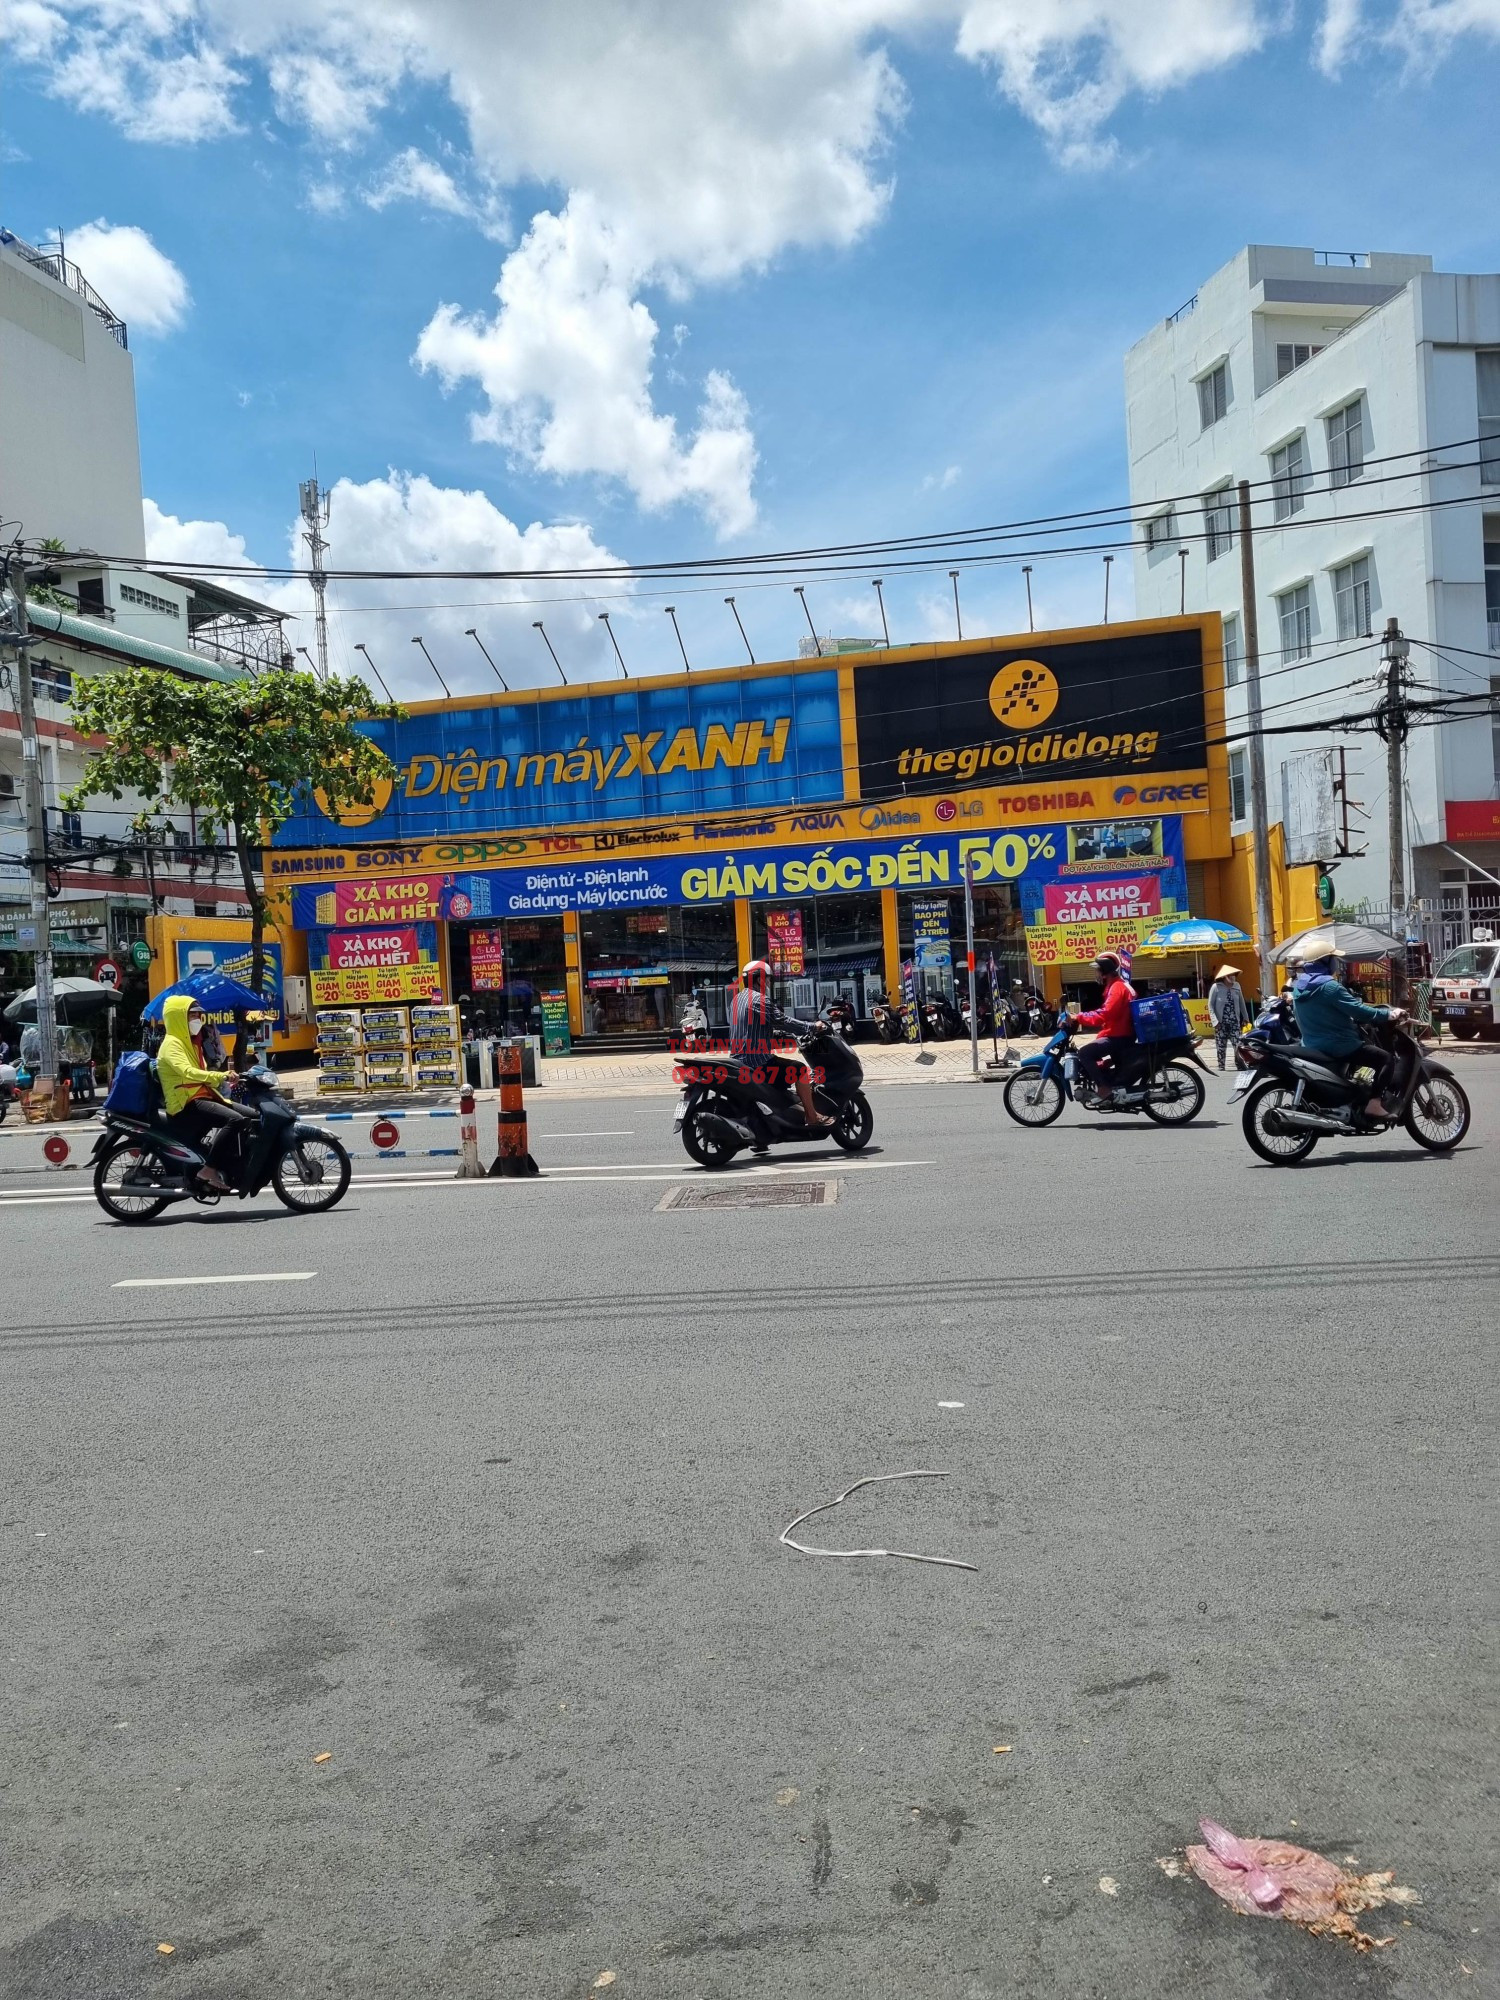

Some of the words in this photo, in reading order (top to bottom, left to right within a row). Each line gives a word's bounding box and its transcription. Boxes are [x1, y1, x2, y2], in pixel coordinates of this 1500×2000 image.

[403, 747, 507, 804] Điện
[515, 737, 620, 790] máy
[615, 718, 791, 777] XANH
[897, 731, 1159, 779] thegioididong
[1139, 783, 1208, 802] GREE
[960, 800, 984, 817] LG
[998, 791, 1095, 814] TOSHIBA
[791, 813, 844, 832] AQUA
[872, 811, 921, 827] Midea
[617, 831, 680, 846] Electrolux
[693, 819, 776, 840] Panasonic
[539, 837, 583, 852] TCL
[271, 855, 345, 874] SAMSUNG
[356, 850, 423, 867] SONY
[681, 856, 777, 900] GIẢM
[783, 847, 863, 892] SỐC
[866, 839, 950, 886] ĐẾN
[958, 832, 1056, 881] 50%
[1091, 864, 1110, 872] KHO
[526, 873, 559, 892] Điện
[559, 872, 576, 887] tử
[584, 869, 617, 888] Điện
[618, 867, 649, 885] lạnh
[354, 881, 381, 902] XẢ
[385, 882, 429, 899] KHO
[509, 895, 531, 909] Gia
[532, 893, 569, 910] dụng
[577, 889, 607, 906] Máy
[608, 888, 629, 905] lọc
[630, 884, 668, 900] nước
[1065, 886, 1093, 904] XẢ
[1096, 885, 1140, 902] KHO
[345, 902, 396, 923] GIẢM
[401, 898, 440, 919] HẾT
[914, 902, 929, 910] Máy
[914, 911, 932, 919] BAO
[932, 910, 947, 918] PHÍ
[1056, 903, 1108, 923] GIẢM
[1112, 898, 1151, 917] HẾT
[785, 928, 796, 936] LG
[922, 919, 940, 928] ĐẾN
[927, 927, 949, 936] TRIỆU
[343, 935, 365, 952] XẢ
[367, 936, 402, 950] KHO
[338, 951, 378, 968] GIẢM
[380, 948, 410, 966] HẾT
[1037, 948, 1063, 962] 20%
